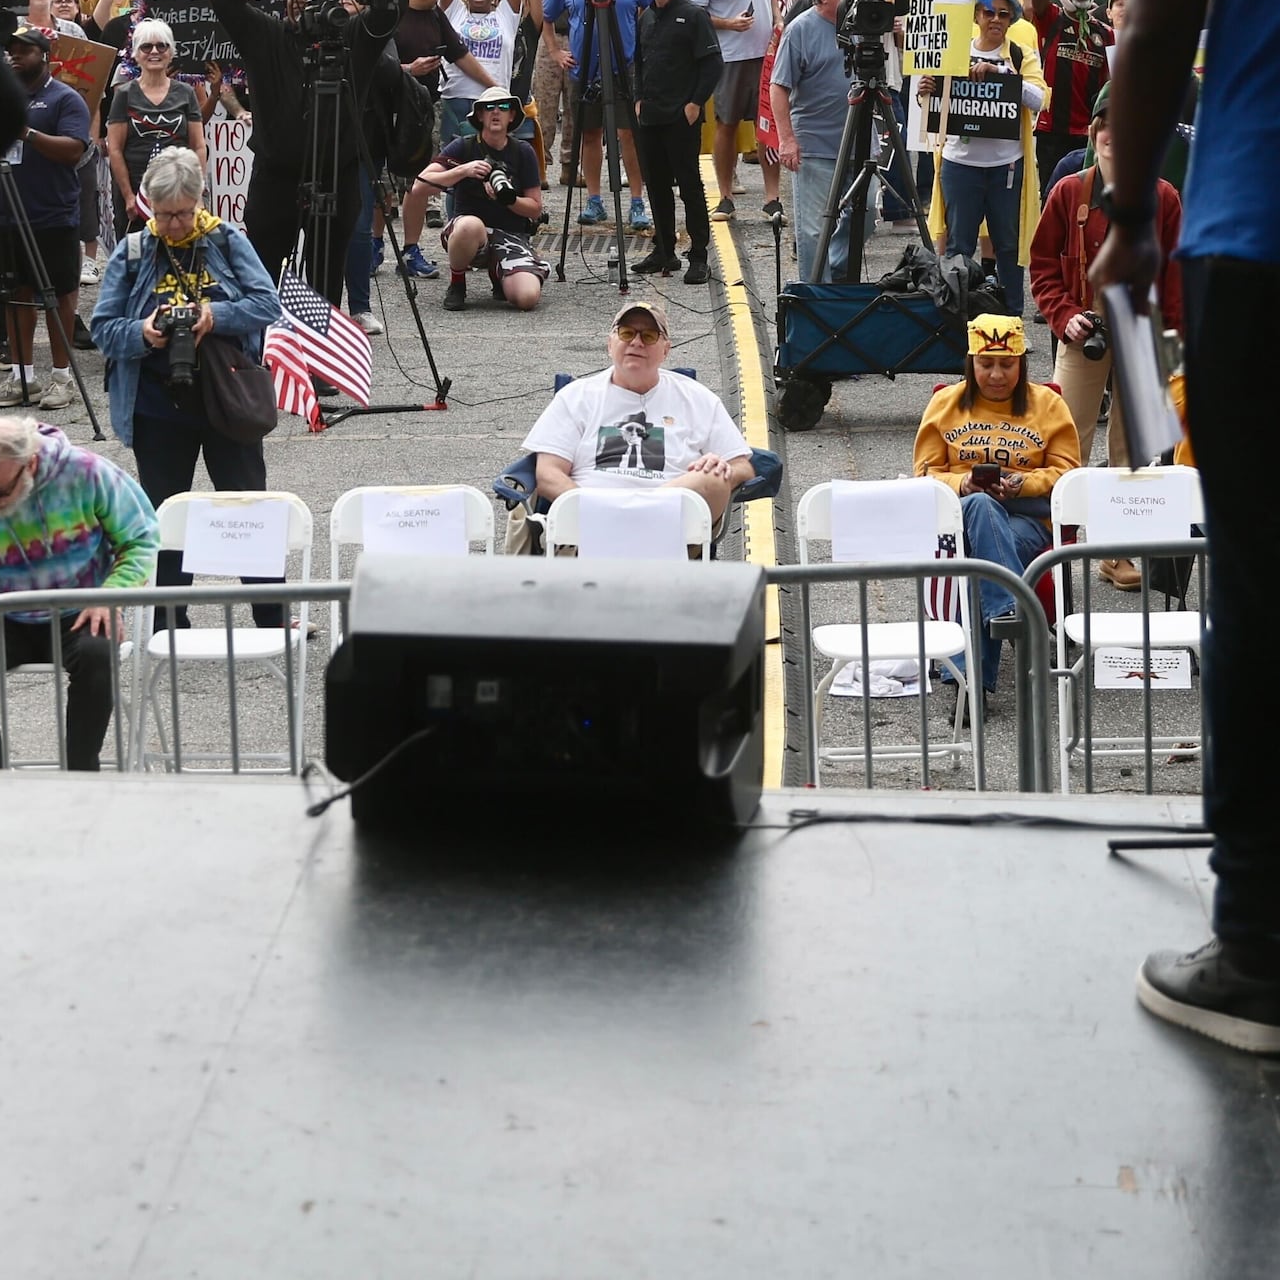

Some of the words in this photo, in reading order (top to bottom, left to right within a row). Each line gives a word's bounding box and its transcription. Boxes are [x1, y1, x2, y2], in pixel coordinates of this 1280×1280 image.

[910, 0, 934, 15] BUT
[907, 15, 946, 32] MARTIN
[906, 32, 948, 52] LUTHER
[913, 52, 941, 69] KING
[952, 81, 1003, 98] ROTECT
[964, 123, 980, 131] ACLU
[215, 122, 245, 151] no
[216, 157, 246, 186] no
[217, 194, 247, 223] no
[997, 435, 1028, 450] Dept.
[1128, 497, 1166, 505] SEATING
[386, 511, 401, 519] ASL
[404, 509, 440, 518] SEATING
[1123, 507, 1153, 516] ONLY!!!
[228, 521, 264, 529] SEATING
[399, 520, 428, 529] ONLY!!!
[221, 530, 251, 539] ONLY!!!
